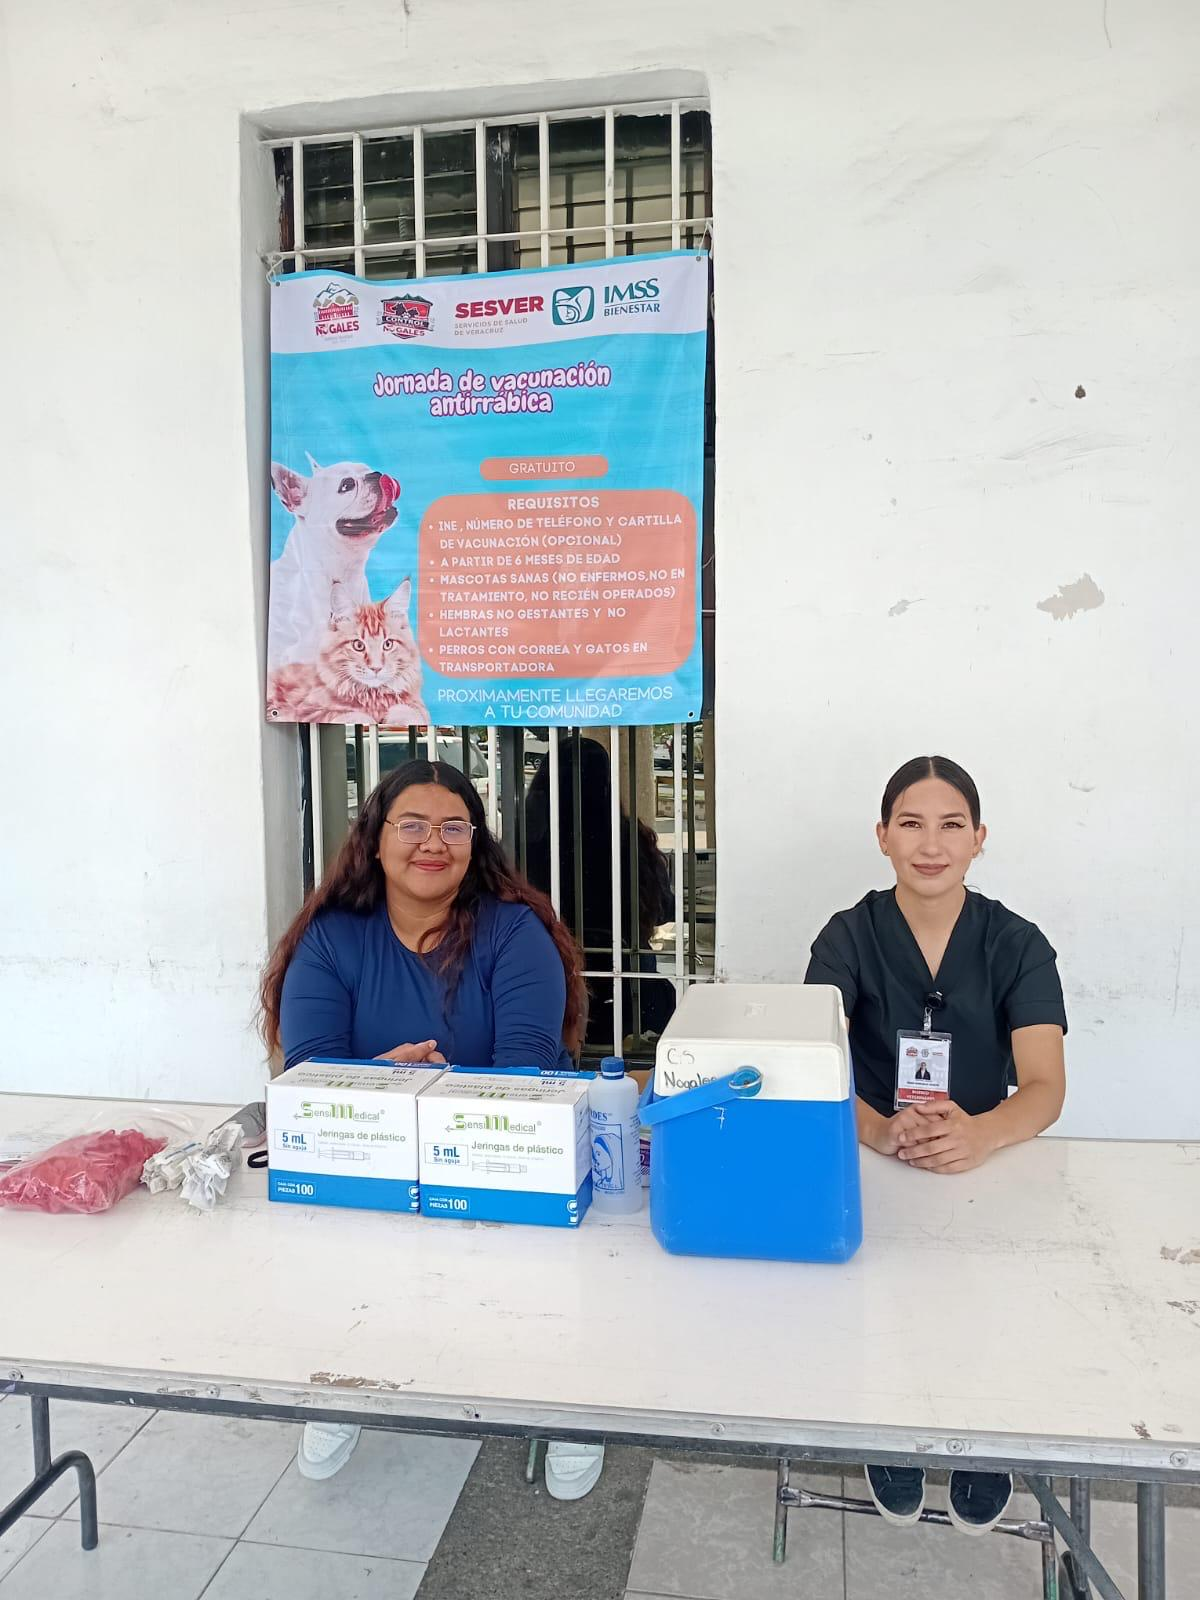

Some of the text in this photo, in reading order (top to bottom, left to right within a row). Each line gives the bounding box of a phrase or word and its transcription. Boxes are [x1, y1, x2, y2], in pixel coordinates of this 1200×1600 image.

[604, 278, 659, 304] IMSS
[455, 296, 544, 319] SESVER
[604, 304, 660, 316] BIENESTAR
[385, 317, 424, 326] CONTROL
[455, 320, 492, 329] SERVICIOS
[466, 327, 504, 335] VERACRUZ
[374, 360, 611, 397] Jornada de vacunación
[430, 389, 553, 417] antirrábica
[509, 462, 576, 474] GRATUITO
[508, 496, 600, 510] REQUISITOS
[466, 518, 514, 530] NÚMERO
[518, 519, 533, 528] DE
[536, 515, 602, 528] TELÉFONO
[606, 516, 614, 527] Y
[618, 514, 682, 527] CARTILLA
[440, 534, 622, 549] DE VACUNACIÓN (OPCIONAL)
[441, 553, 620, 566] A PARTIR DE 6 MESES DE EDAD
[440, 574, 507, 584] MASCOTAS
[510, 572, 549, 583] SANAS
[552, 572, 577, 583] (NO
[671, 568, 685, 579] EN
[440, 586, 676, 602] TRATAMIENTO, NO RECIÉN OPERADOS)
[440, 607, 626, 620] HEMBRAS NO GESTANTES Y NO
[440, 626, 508, 637] LACTANTES
[440, 642, 648, 655] PERROS CON CORREA Y GATOS EN
[440, 661, 554, 672] TRANSPORTADORA
[438, 686, 672, 703] PROXIMAMENTE LLEGAREMOS
[484, 704, 622, 718] A TU COMUNIDAD
[713, 1107, 726, 1130] 7
[282, 1132, 306, 1144] 5 mL
[317, 1128, 406, 1142] Jeringas de plástico
[434, 1146, 439, 1156] 5
[444, 1147, 460, 1157] mL
[471, 1141, 564, 1154] Jeringas de plástico
[296, 1184, 313, 1195] 100
[448, 1199, 467, 1210] 100
